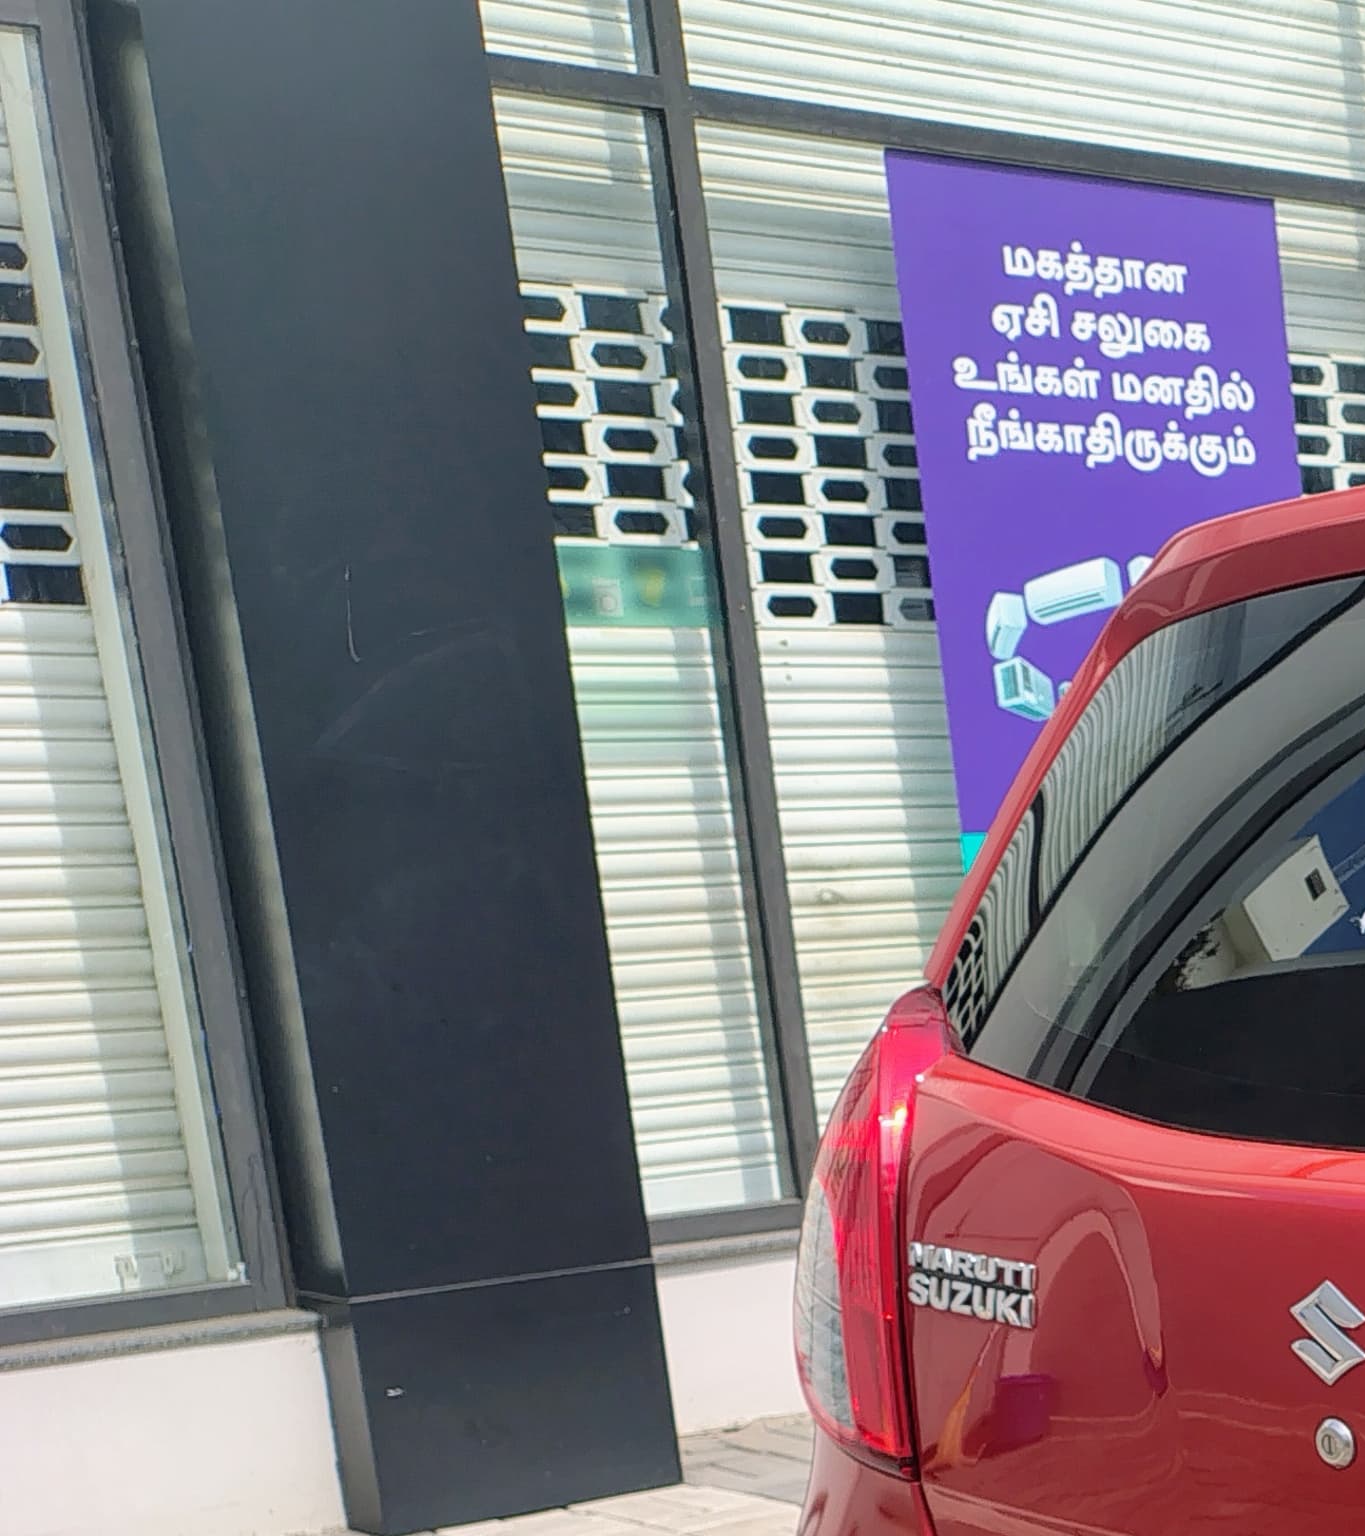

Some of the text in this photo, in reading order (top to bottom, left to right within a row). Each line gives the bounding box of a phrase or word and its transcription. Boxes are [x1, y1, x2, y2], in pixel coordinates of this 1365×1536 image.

[1002, 240, 1188, 298] மகத்தான
[991, 292, 1211, 358] ஏசி சலுகை
[952, 350, 1255, 420] உங்கள் மனதில்
[966, 402, 1256, 477] நீங்காதிருக்கும்
[907, 1242, 1036, 1291] MARUTI
[907, 1271, 1036, 1329] SUZUKI
